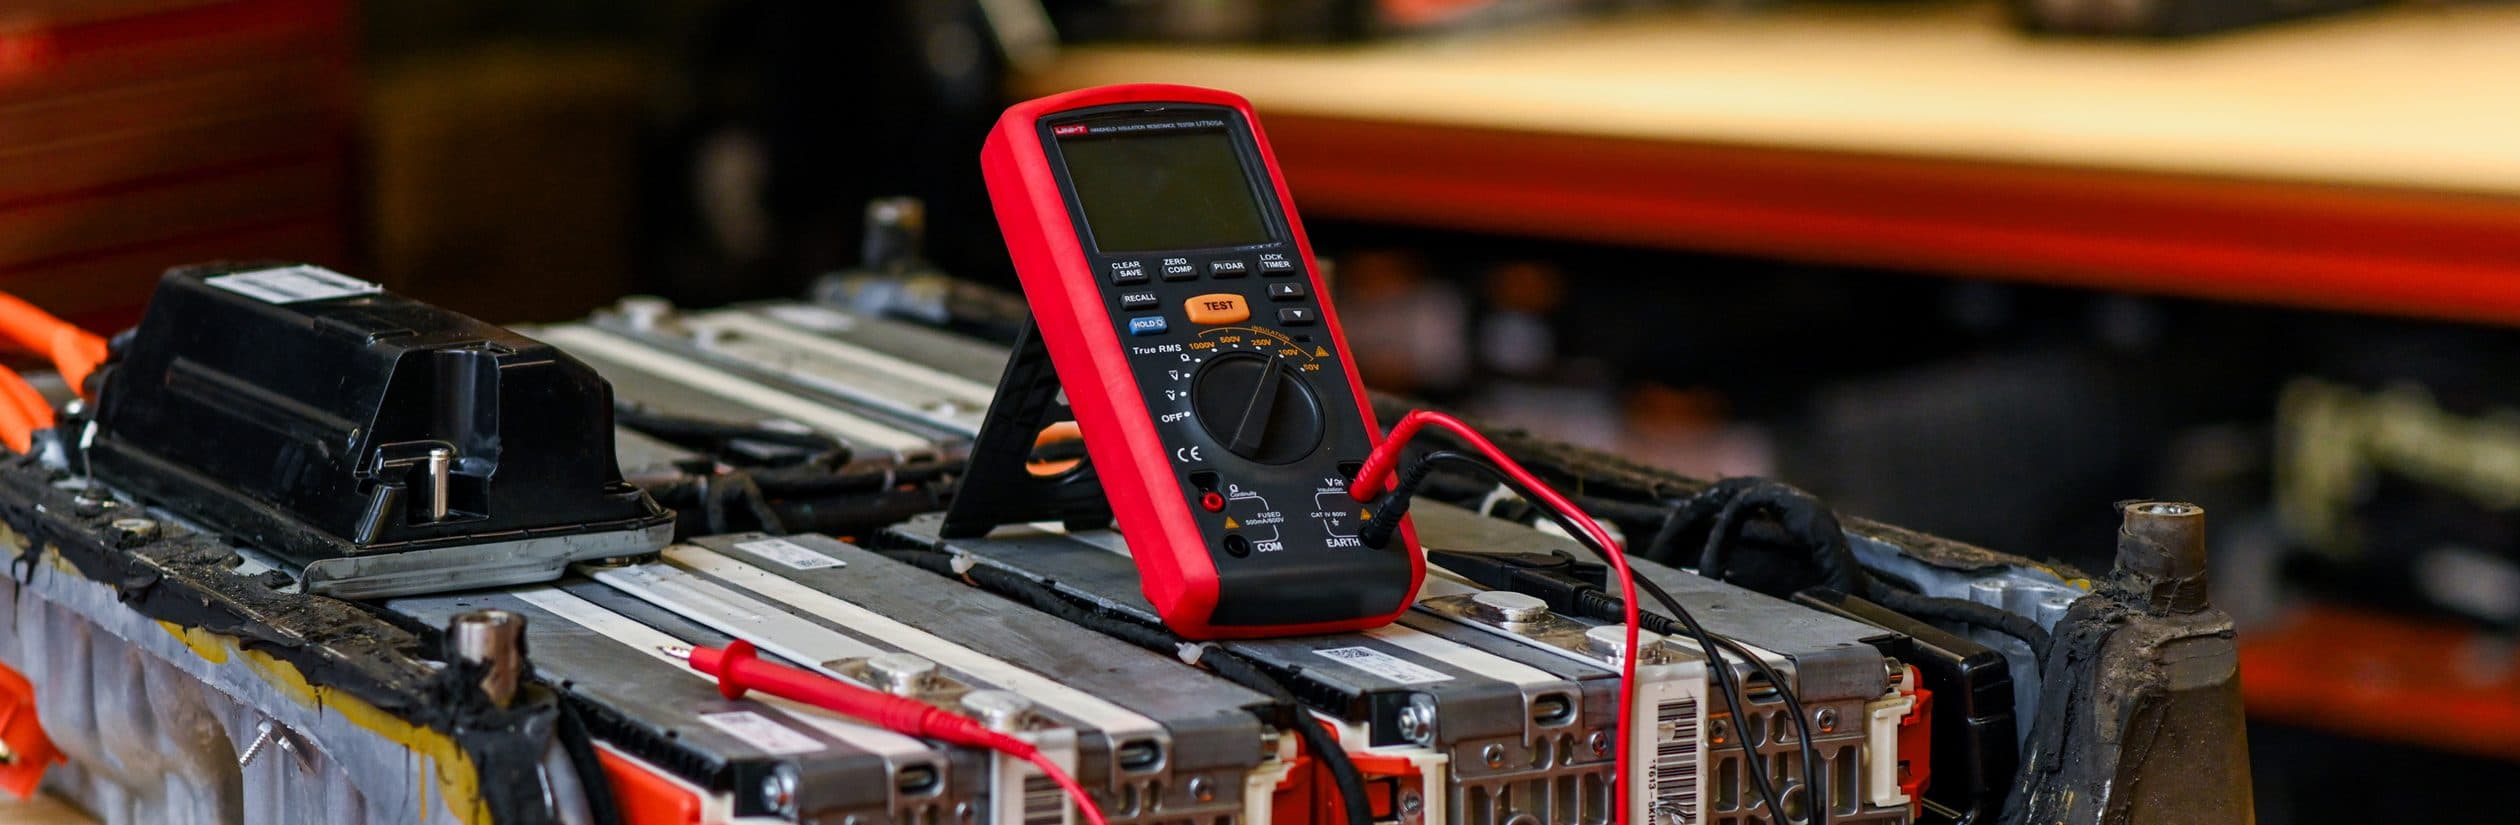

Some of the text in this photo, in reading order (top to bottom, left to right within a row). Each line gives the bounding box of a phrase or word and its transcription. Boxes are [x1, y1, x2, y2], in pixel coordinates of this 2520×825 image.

[1163, 257, 1187, 266] ZERO
[1259, 253, 1284, 261] LOCK
[1111, 261, 1141, 270] CLEAR
[1264, 260, 1291, 269] TIMER
[1120, 269, 1143, 278] SAVE
[1167, 265, 1193, 274] COMP
[1124, 294, 1156, 302] RECALL
[1203, 301, 1233, 311] TEST
[1134, 320, 1155, 329] HOLD
[1250, 325, 1291, 342] INSULATION
[1219, 335, 1241, 344] 500V
[1250, 337, 1272, 347] 250V
[1133, 343, 1182, 355] True RMS
[1189, 341, 1215, 350] 1000V
[1303, 363, 1320, 371] 50V
[1161, 412, 1183, 423] OFF
[1257, 511, 1281, 519] FUSED
[1257, 542, 1283, 553] COM
[1326, 538, 1361, 548] EARTH
